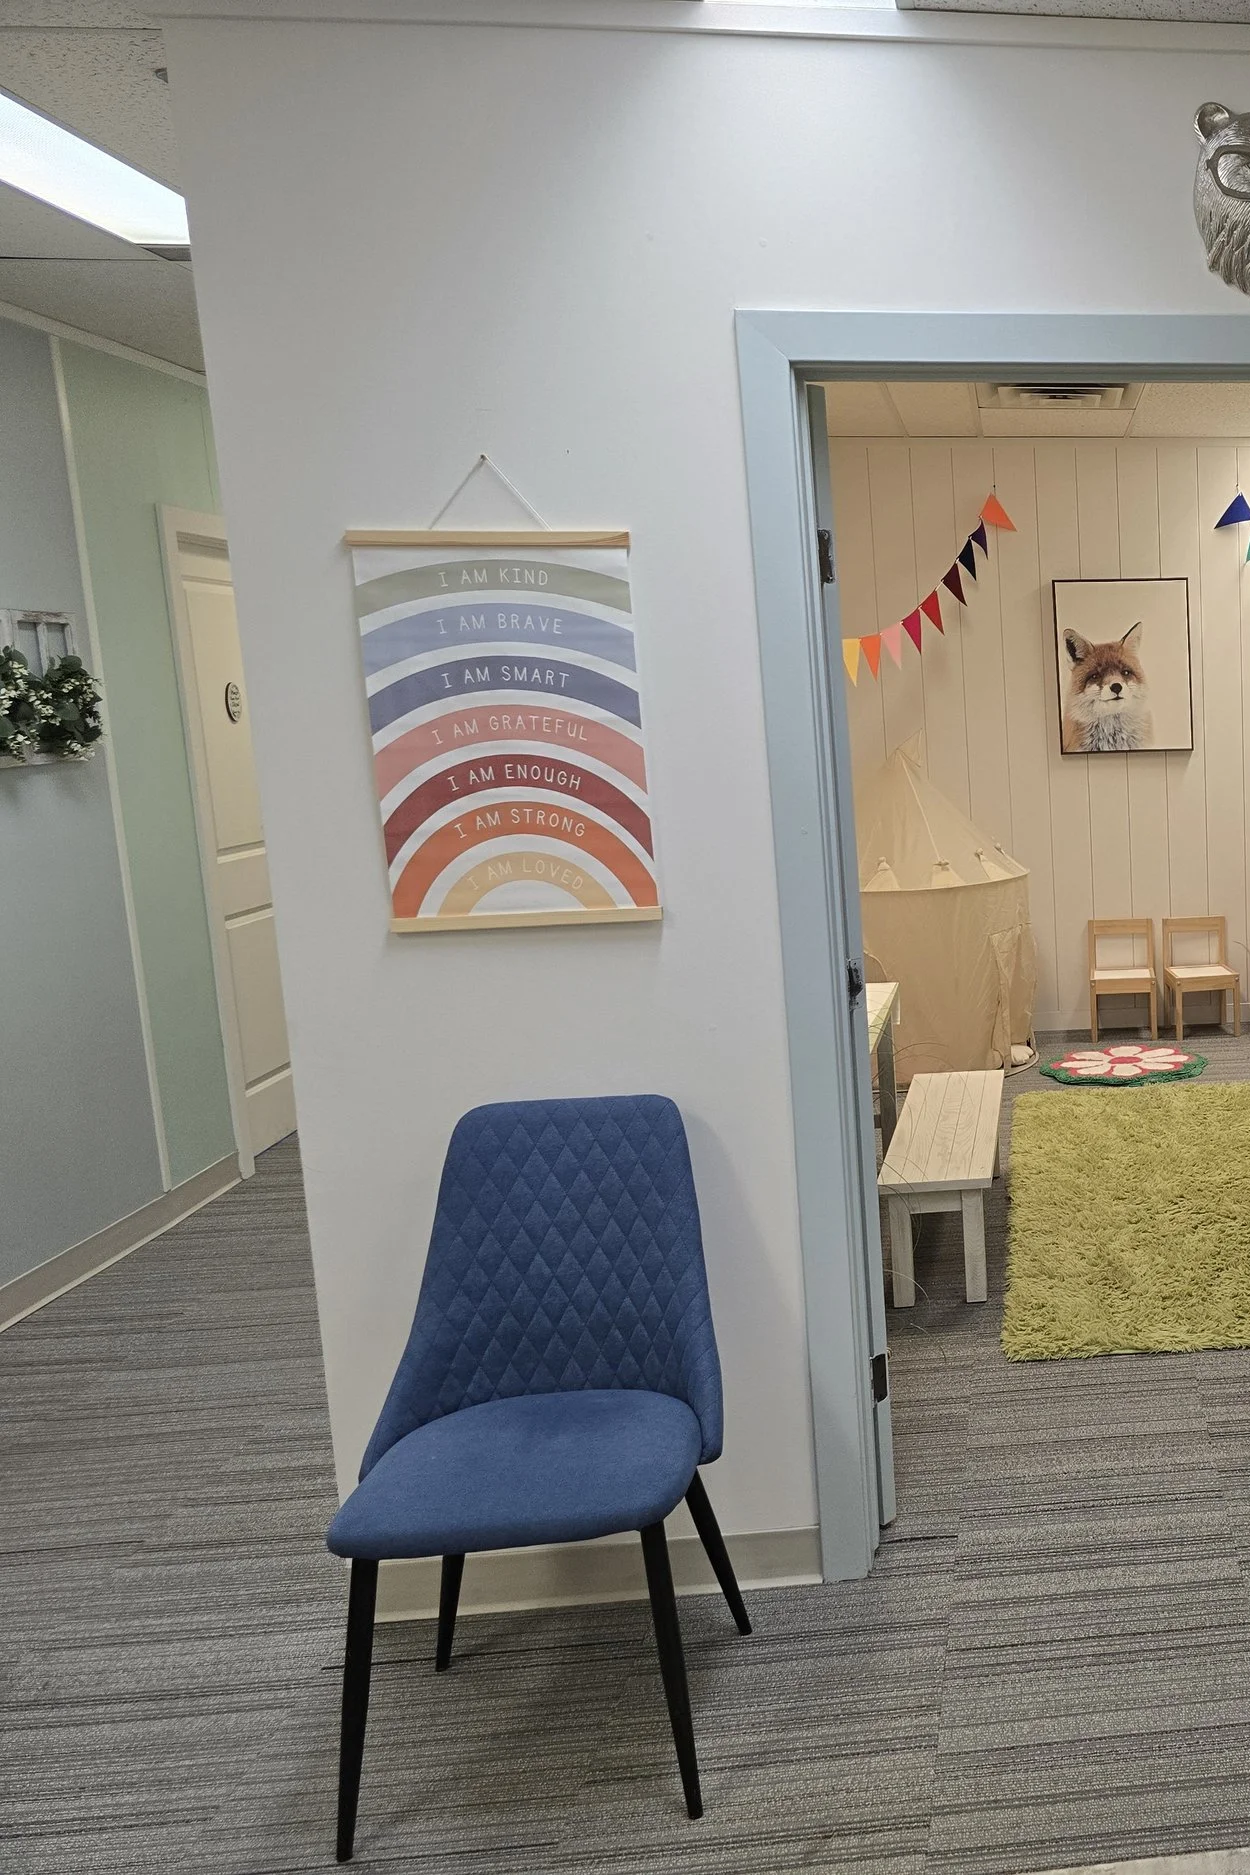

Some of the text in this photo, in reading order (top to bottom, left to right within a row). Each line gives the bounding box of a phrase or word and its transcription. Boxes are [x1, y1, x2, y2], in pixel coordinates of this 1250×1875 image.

[439, 568, 549, 587] I AM KIND
[438, 613, 563, 635] I AM BRAVE
[442, 665, 570, 689] I AM SMART
[431, 715, 588, 745] I AM GRATEFUL
[448, 763, 582, 792] I AM ENOUGH
[454, 808, 586, 839] I AM STRONG
[466, 859, 584, 891] I AM LOVED
